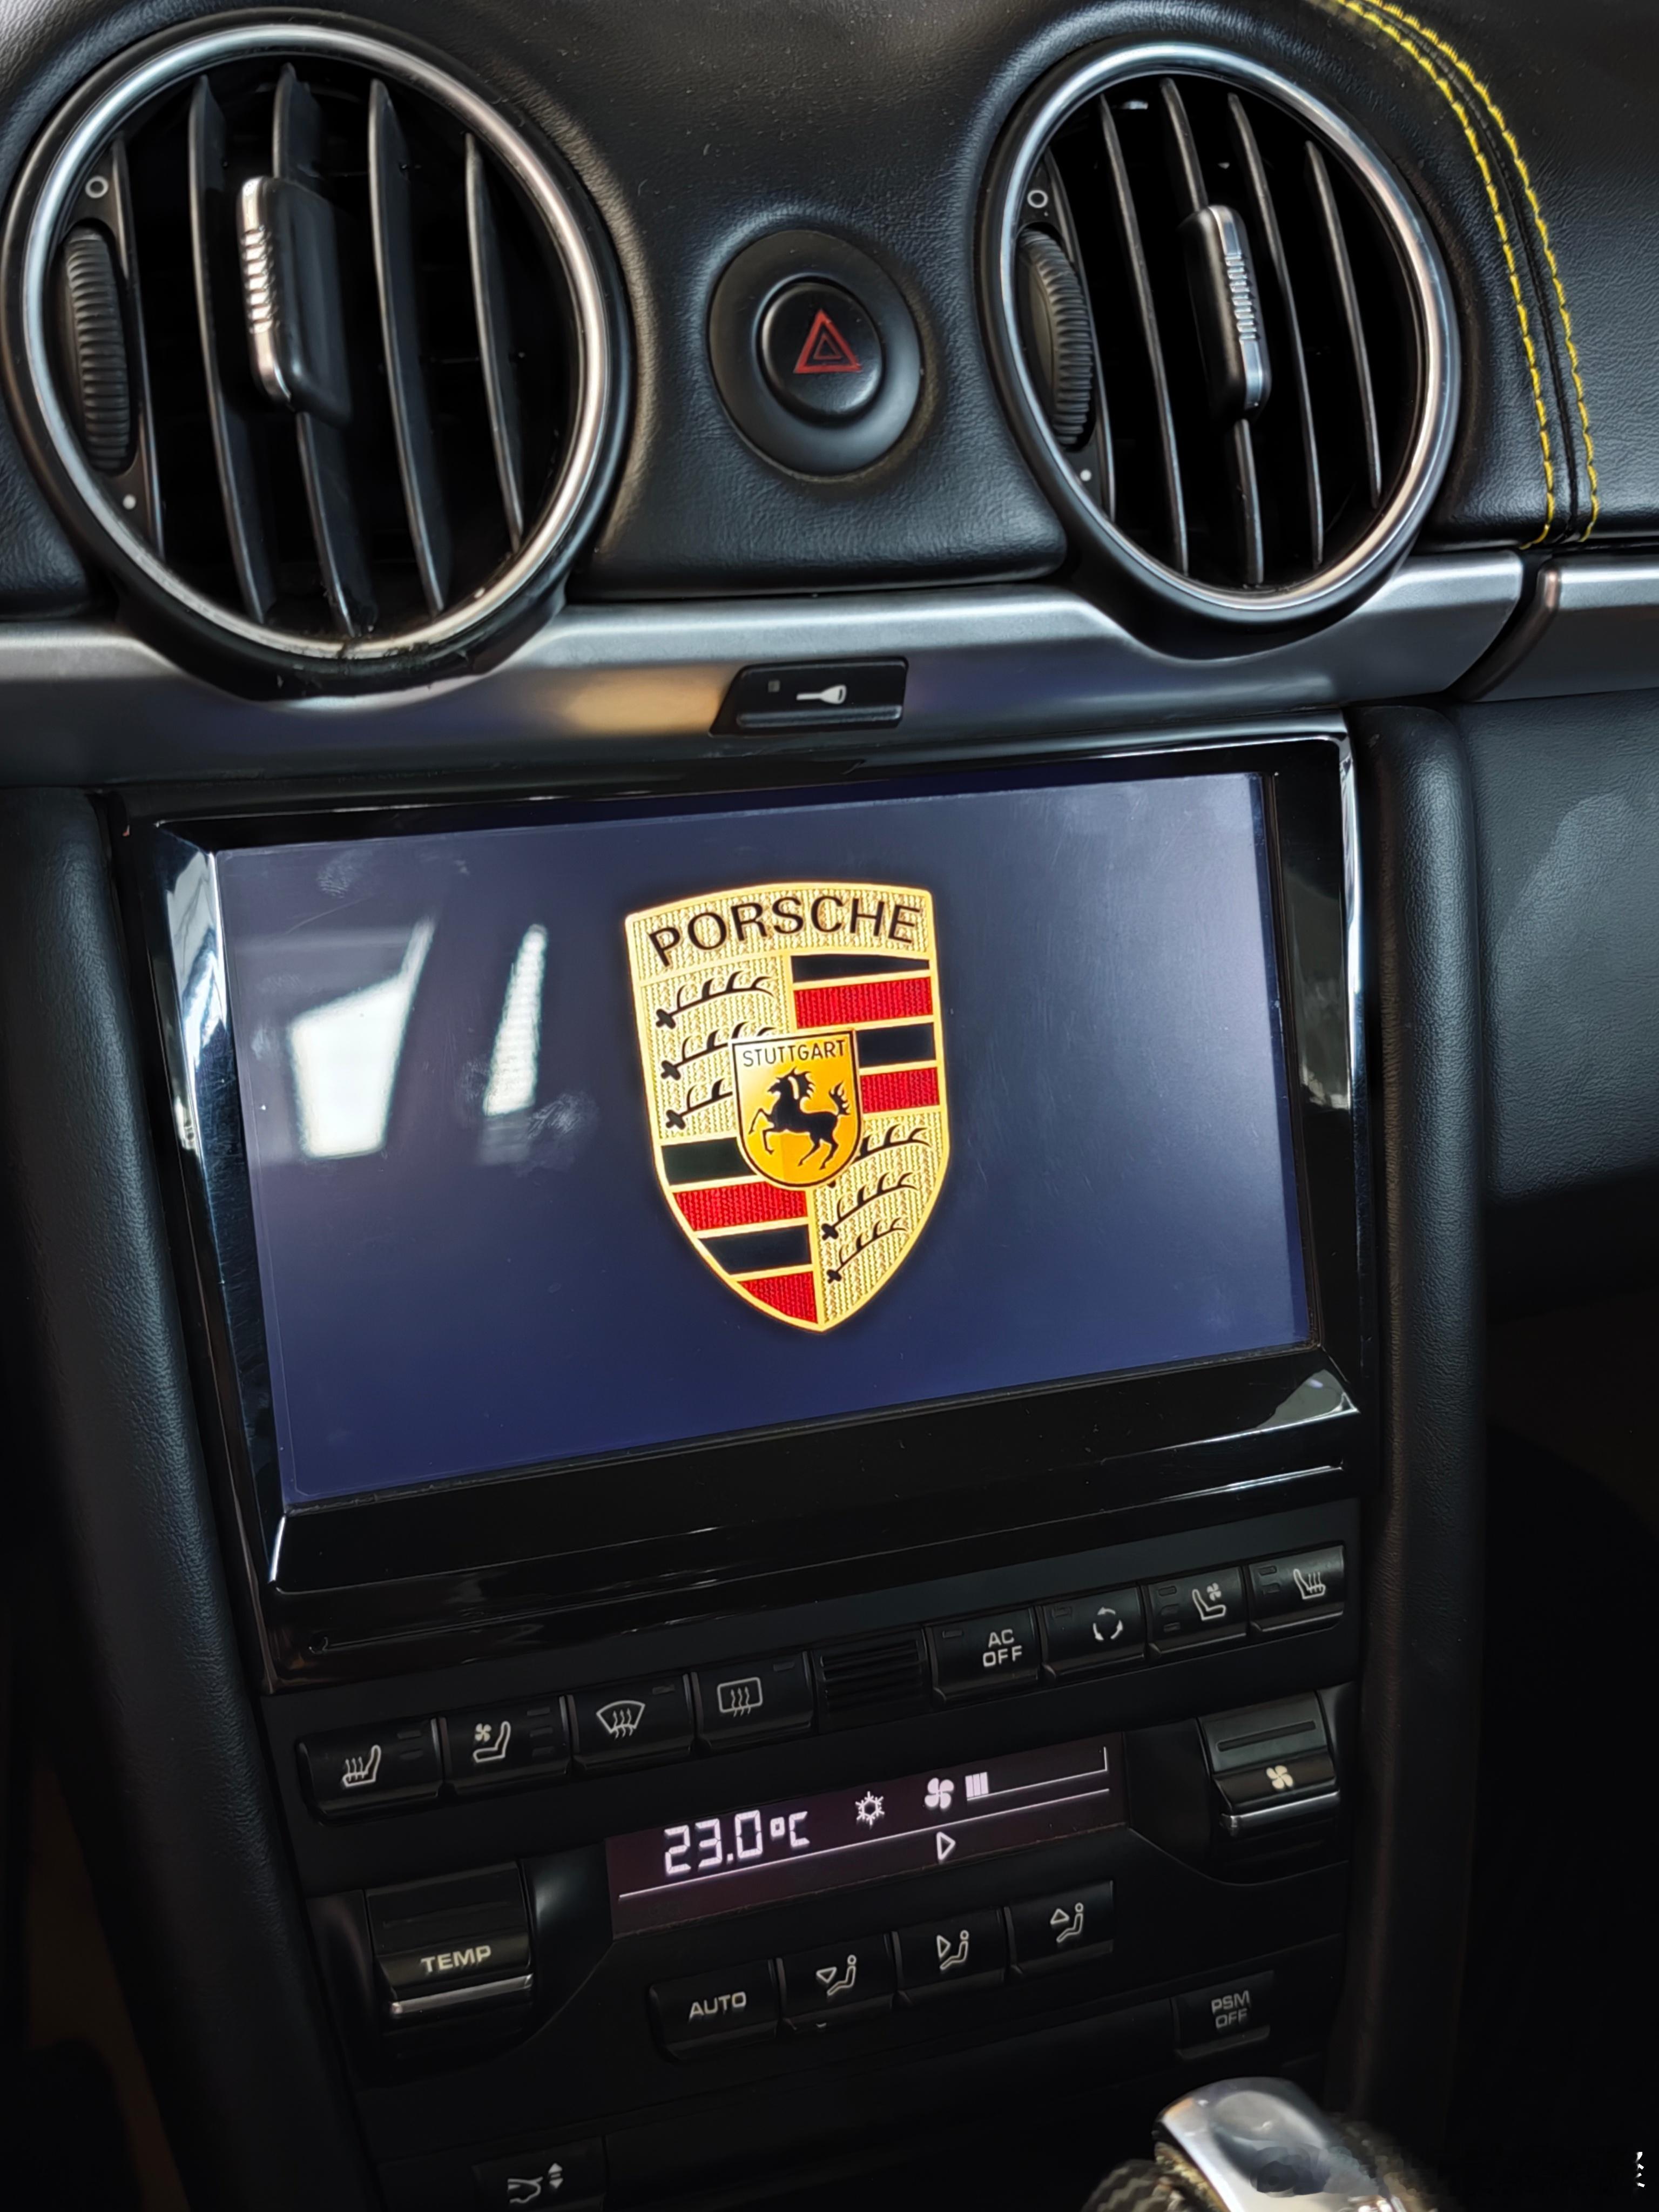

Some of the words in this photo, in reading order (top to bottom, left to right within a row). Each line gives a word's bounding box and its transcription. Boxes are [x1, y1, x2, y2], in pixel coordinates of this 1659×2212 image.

[648, 895, 920, 967] PORSCHE
[743, 1040, 845, 1067] STUTTGART
[988, 1629, 1015, 1648] AC
[982, 1645, 1022, 1667] OFF
[420, 1945, 491, 1973] TEMP
[689, 1991, 747, 2019] AUTO
[1211, 1990, 1250, 2014] PSM
[1215, 2008, 1247, 2029] OFF
